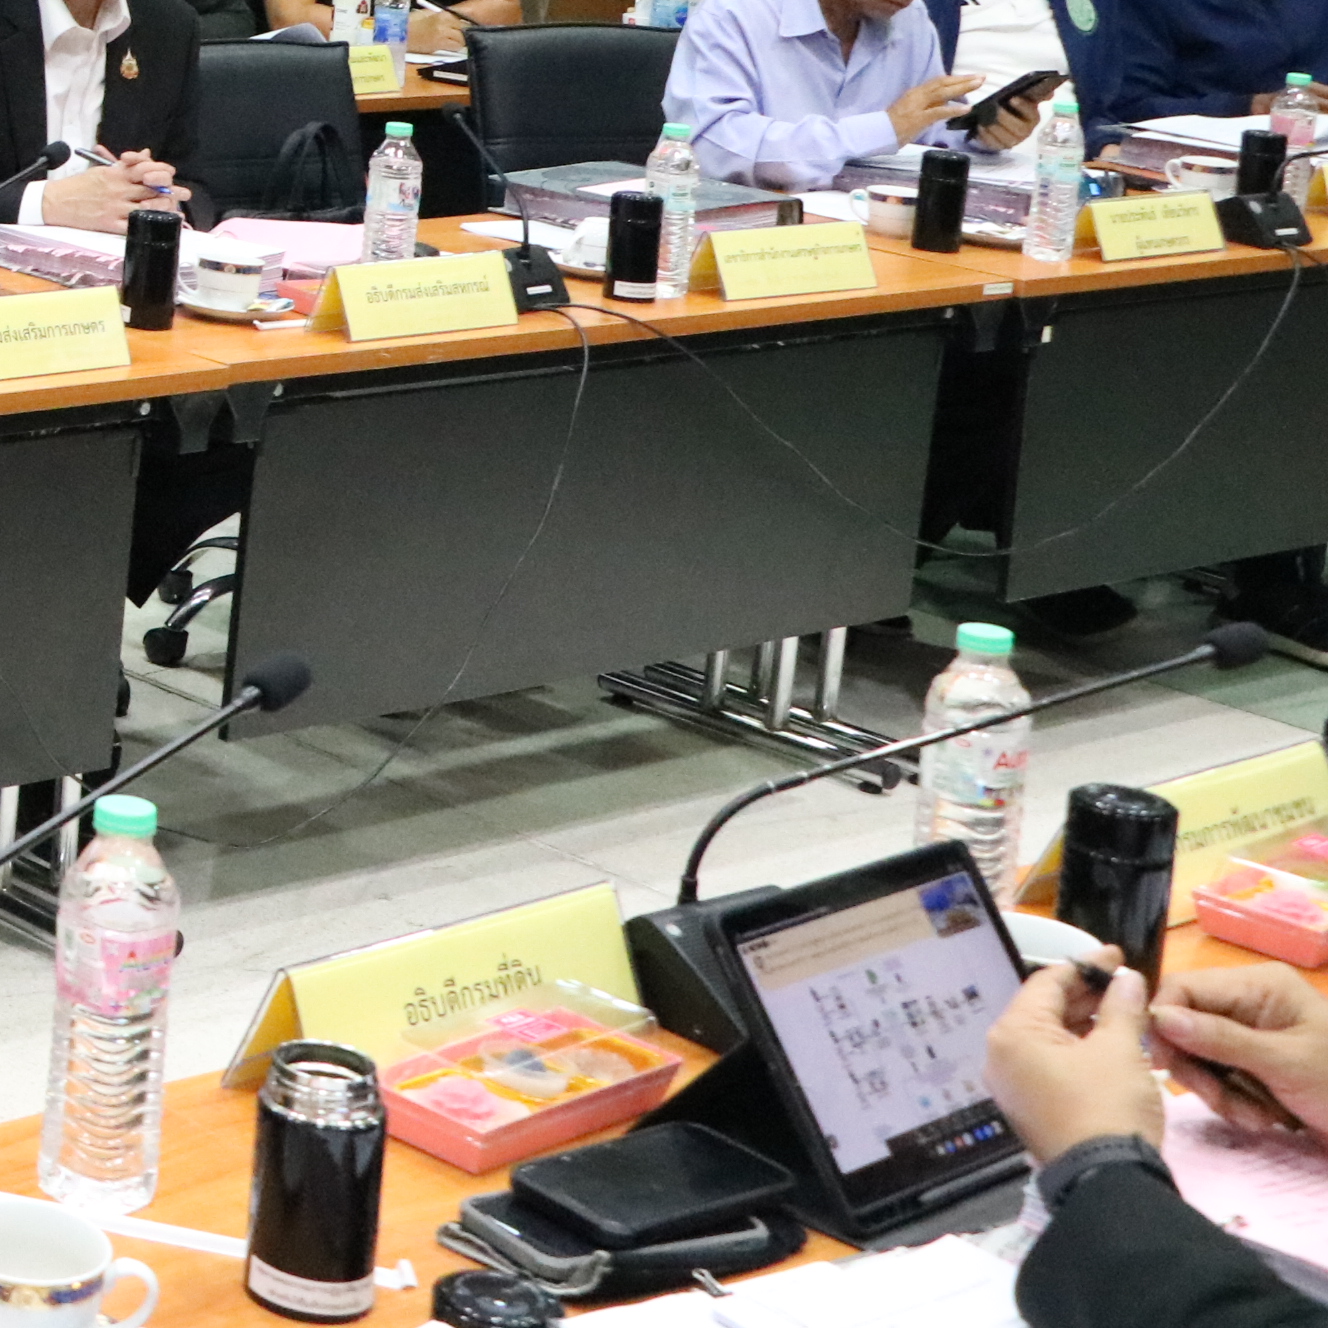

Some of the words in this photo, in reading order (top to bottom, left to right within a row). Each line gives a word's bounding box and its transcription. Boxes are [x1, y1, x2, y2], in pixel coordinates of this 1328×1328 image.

[404, 952, 543, 1026] อธิบดีกรมที่ดิน
